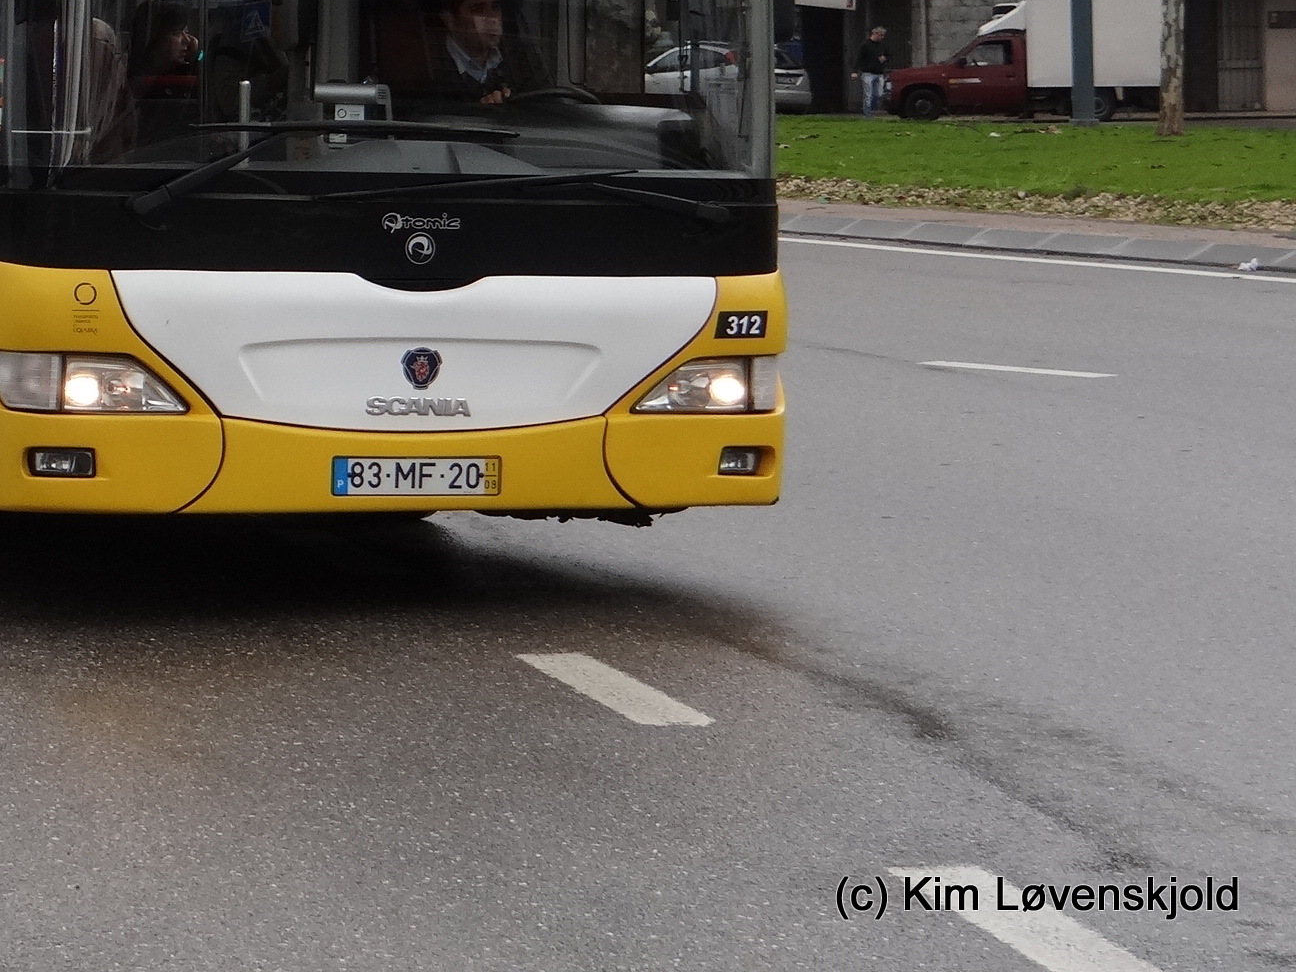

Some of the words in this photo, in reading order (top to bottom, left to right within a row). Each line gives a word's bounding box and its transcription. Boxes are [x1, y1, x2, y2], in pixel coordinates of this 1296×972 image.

[725, 315, 761, 335] 312
[365, 395, 471, 417] SCANIA
[484, 462, 497, 471] 11
[336, 480, 344, 488] P
